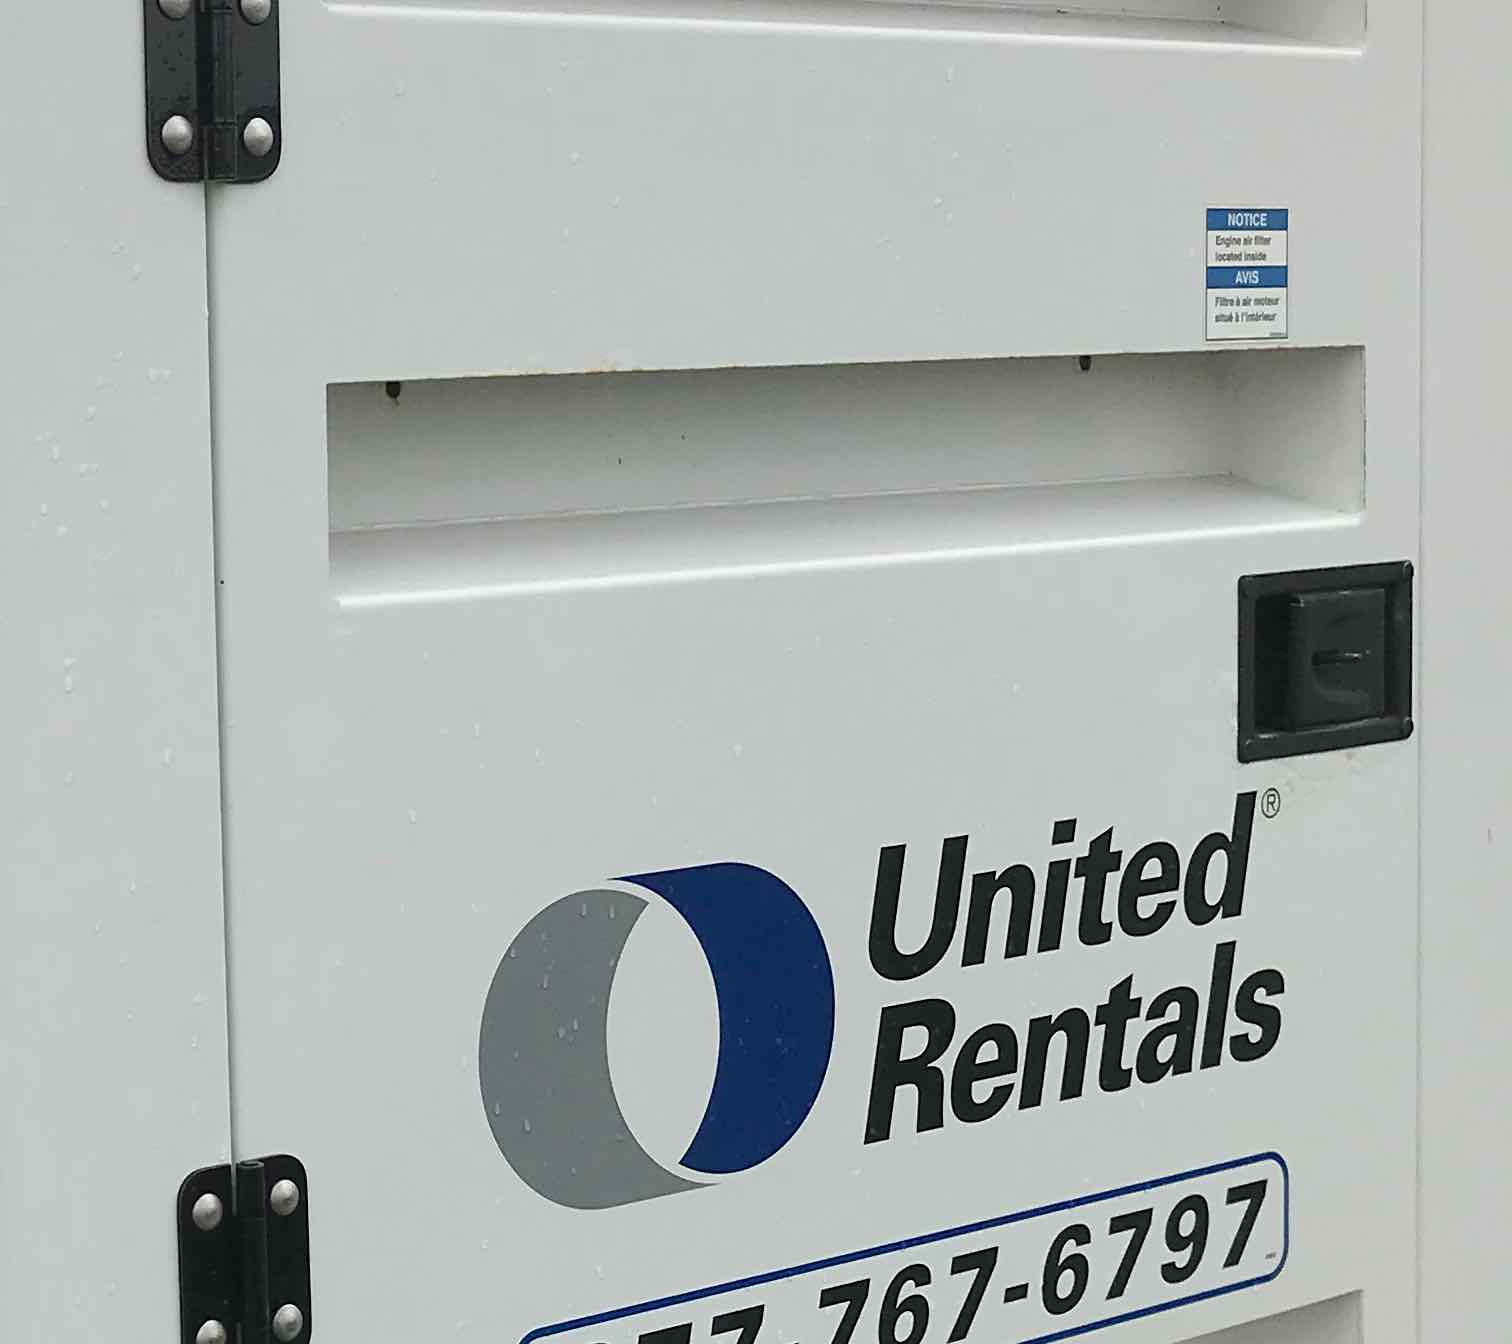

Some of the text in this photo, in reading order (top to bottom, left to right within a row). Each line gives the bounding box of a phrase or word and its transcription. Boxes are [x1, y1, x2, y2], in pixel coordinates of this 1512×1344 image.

[1228, 213, 1267, 226] NOTICE
[1235, 271, 1259, 284] AVIS
[863, 941, 1286, 1145] Rentals
